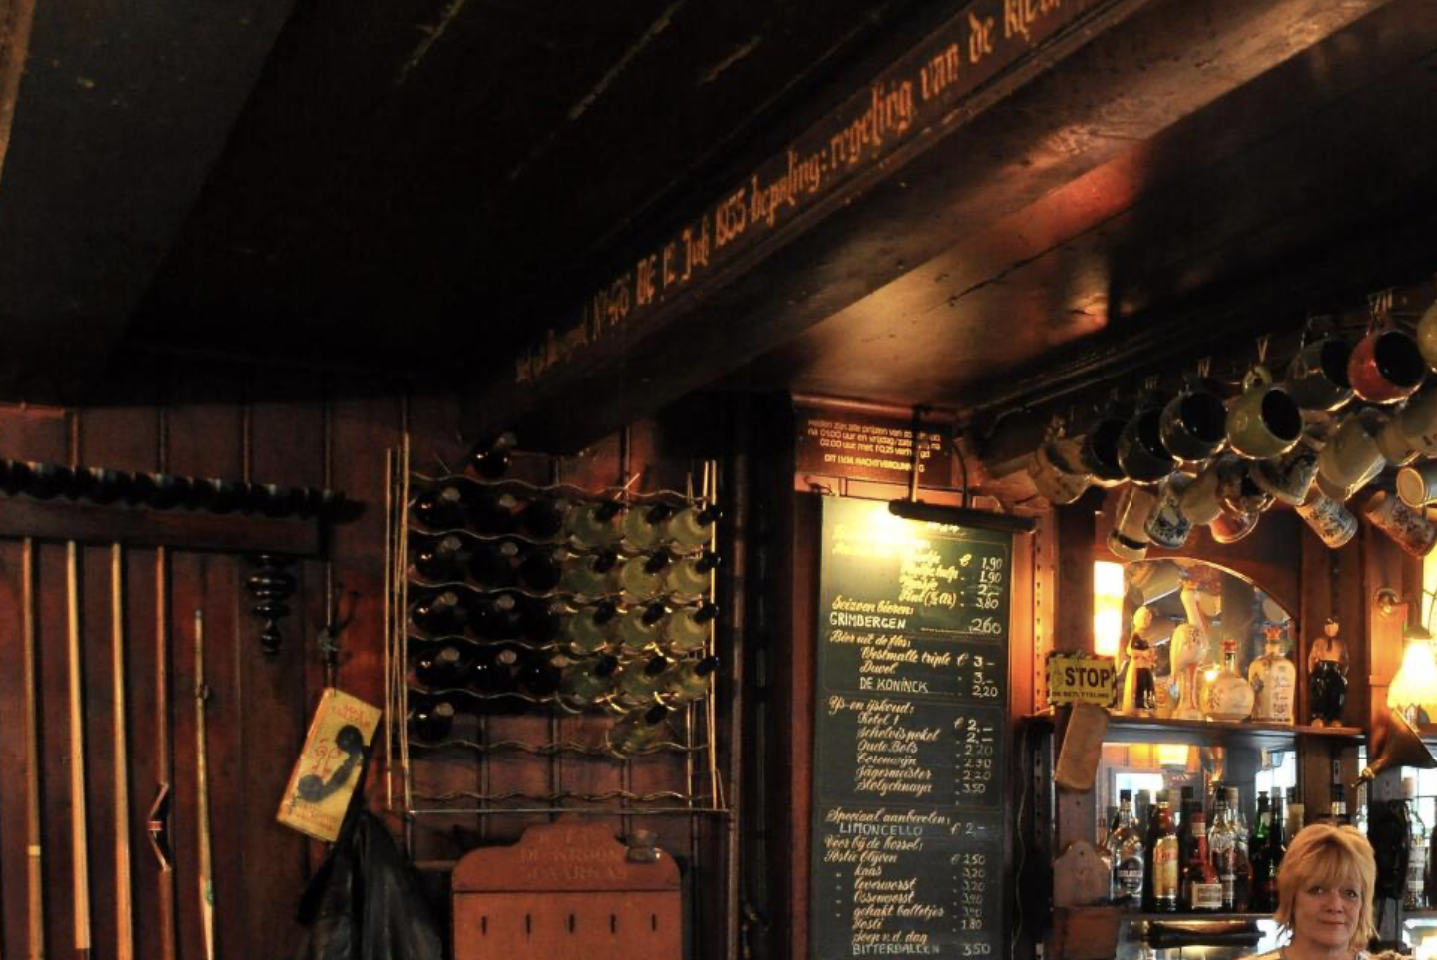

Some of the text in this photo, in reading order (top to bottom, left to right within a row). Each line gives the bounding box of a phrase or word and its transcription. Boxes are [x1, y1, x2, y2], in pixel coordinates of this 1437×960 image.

[829, 612, 907, 630] GRIMBERGEN
[860, 676, 875, 691] DE
[1065, 666, 1110, 688] STOP
[838, 821, 923, 838] LIMONCELLO
